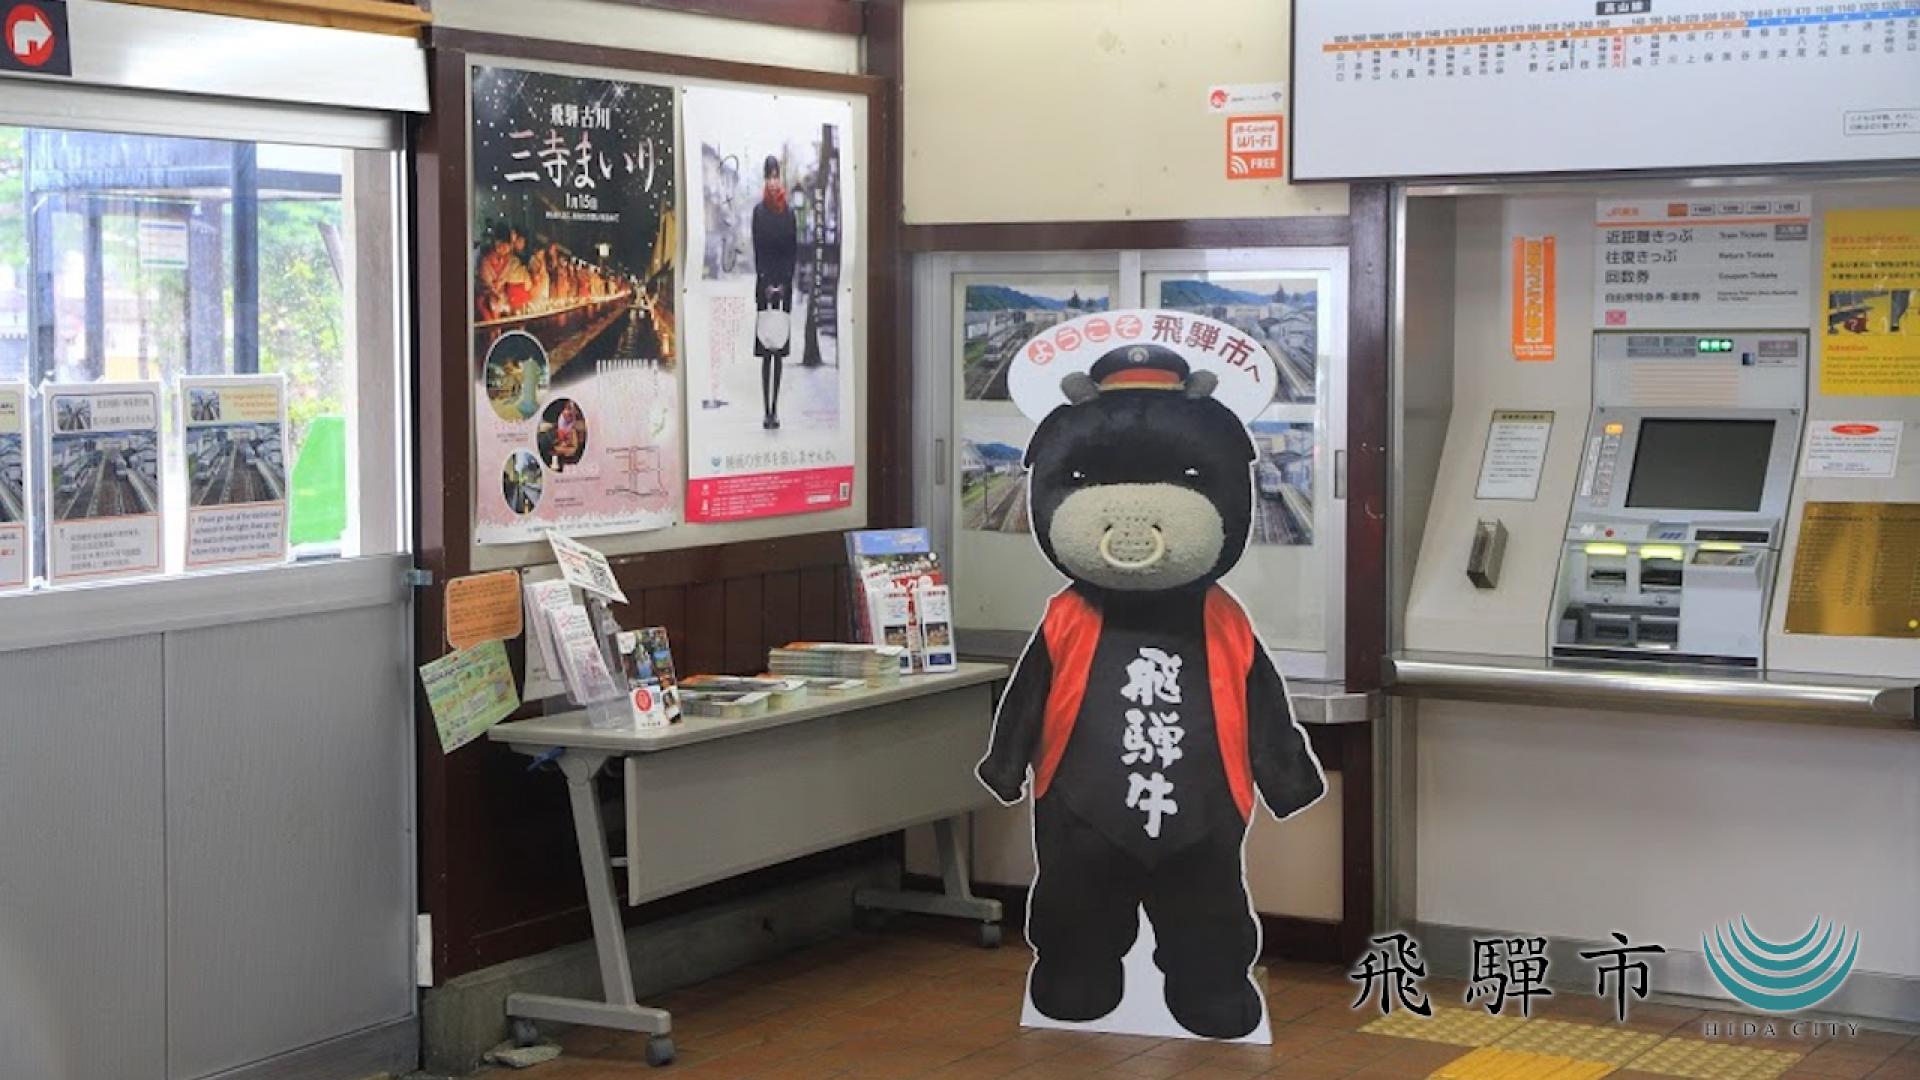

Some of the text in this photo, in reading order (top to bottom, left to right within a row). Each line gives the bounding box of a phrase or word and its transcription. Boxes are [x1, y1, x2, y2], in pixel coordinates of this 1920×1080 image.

[1236, 134, 1273, 148] Wi-Fi
[504, 129, 655, 193] 三寺まいり
[1250, 157, 1276, 169] FREE
[1605, 228, 1694, 244] 近距離きっぷ
[1740, 230, 1768, 239] Tickets
[1605, 249, 1678, 264] 往復きっぷ
[1718, 251, 1775, 260] Return Tickets
[1605, 270, 1650, 284] 回数券
[1718, 271, 1779, 281] Coupon Tickets
[1027, 314, 1262, 384] ようこそ 飛騨市へ
[1121, 647, 1185, 838] 飛騨牛
